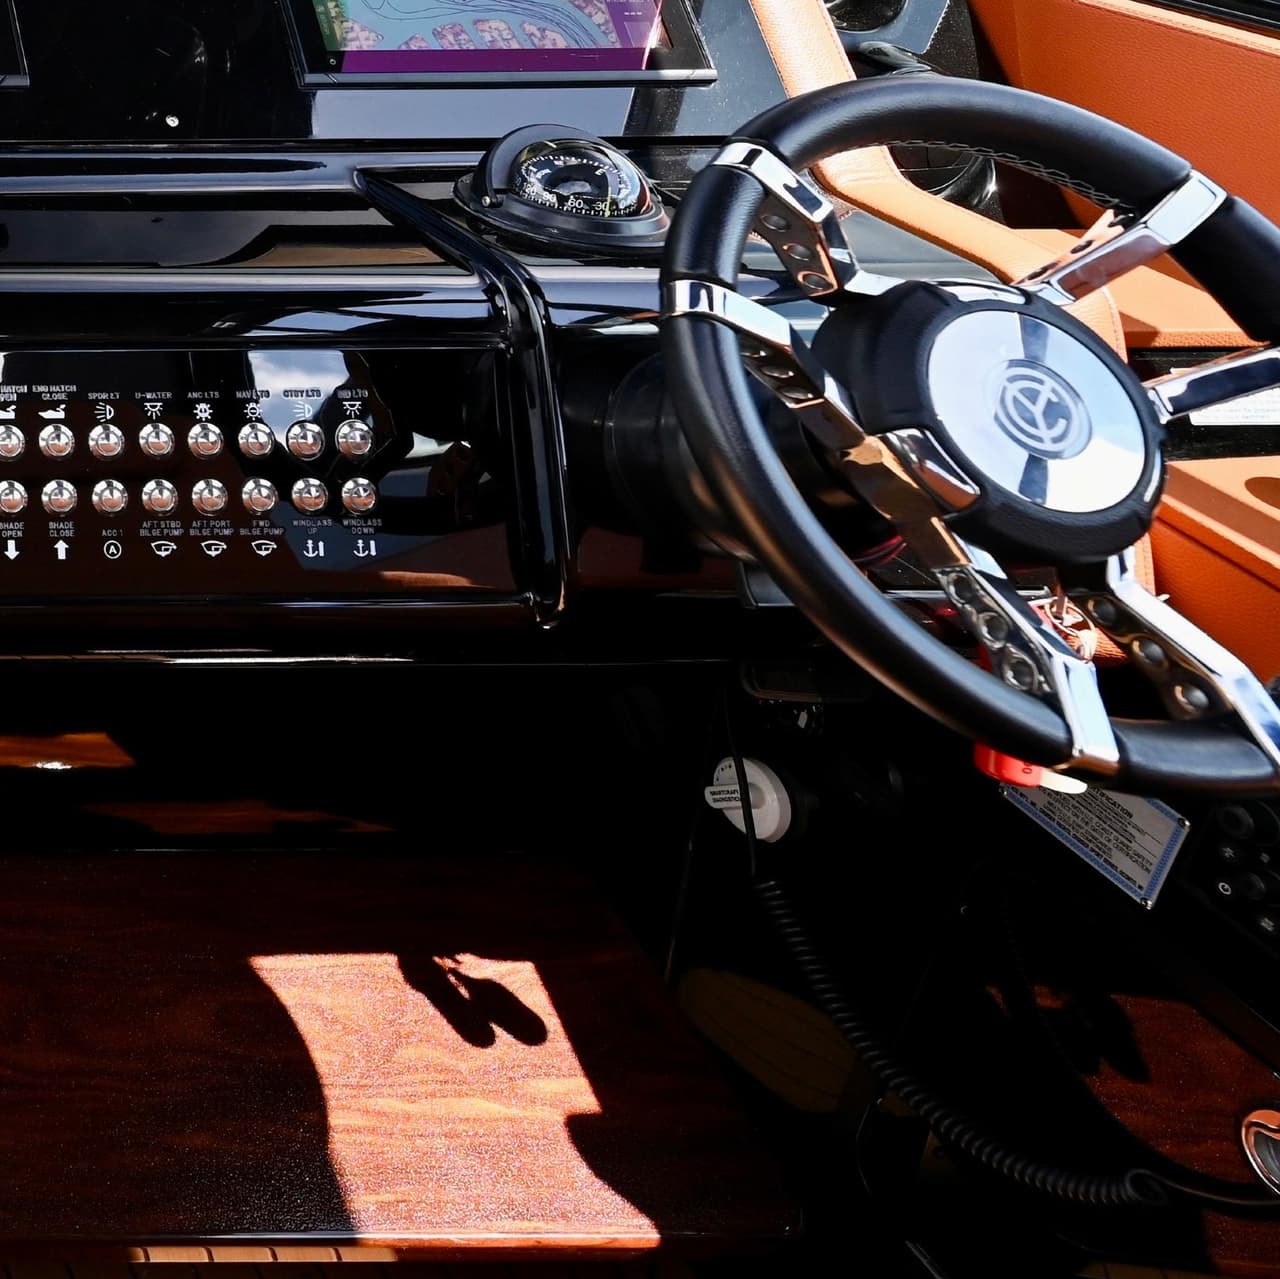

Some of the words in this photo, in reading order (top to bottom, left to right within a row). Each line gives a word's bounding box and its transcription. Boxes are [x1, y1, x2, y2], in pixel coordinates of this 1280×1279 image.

[542, 192, 557, 203] 90
[567, 199, 584, 209] 60
[135, 391, 172, 399] U-WATER
[187, 391, 203, 399] ANC
[205, 391, 220, 399] LTS
[0, 522, 25, 530] SHADE
[48, 521, 75, 529] SHADE
[142, 520, 159, 528] AFT
[160, 520, 181, 528] STBD
[293, 519, 333, 527] WINDLASS
[1, 530, 23, 538] OPEN
[49, 529, 75, 537] CLOSE
[101, 529, 118, 537] ACC
[140, 528, 162, 536] BILGE
[163, 528, 184, 536] PUMP
[190, 528, 212, 536] BILGE
[213, 528, 235, 536] PUMP
[240, 528, 263, 536] BILGE
[264, 528, 285, 536] PUMP
[307, 527, 318, 535] UP
[351, 527, 375, 535] DOWN
